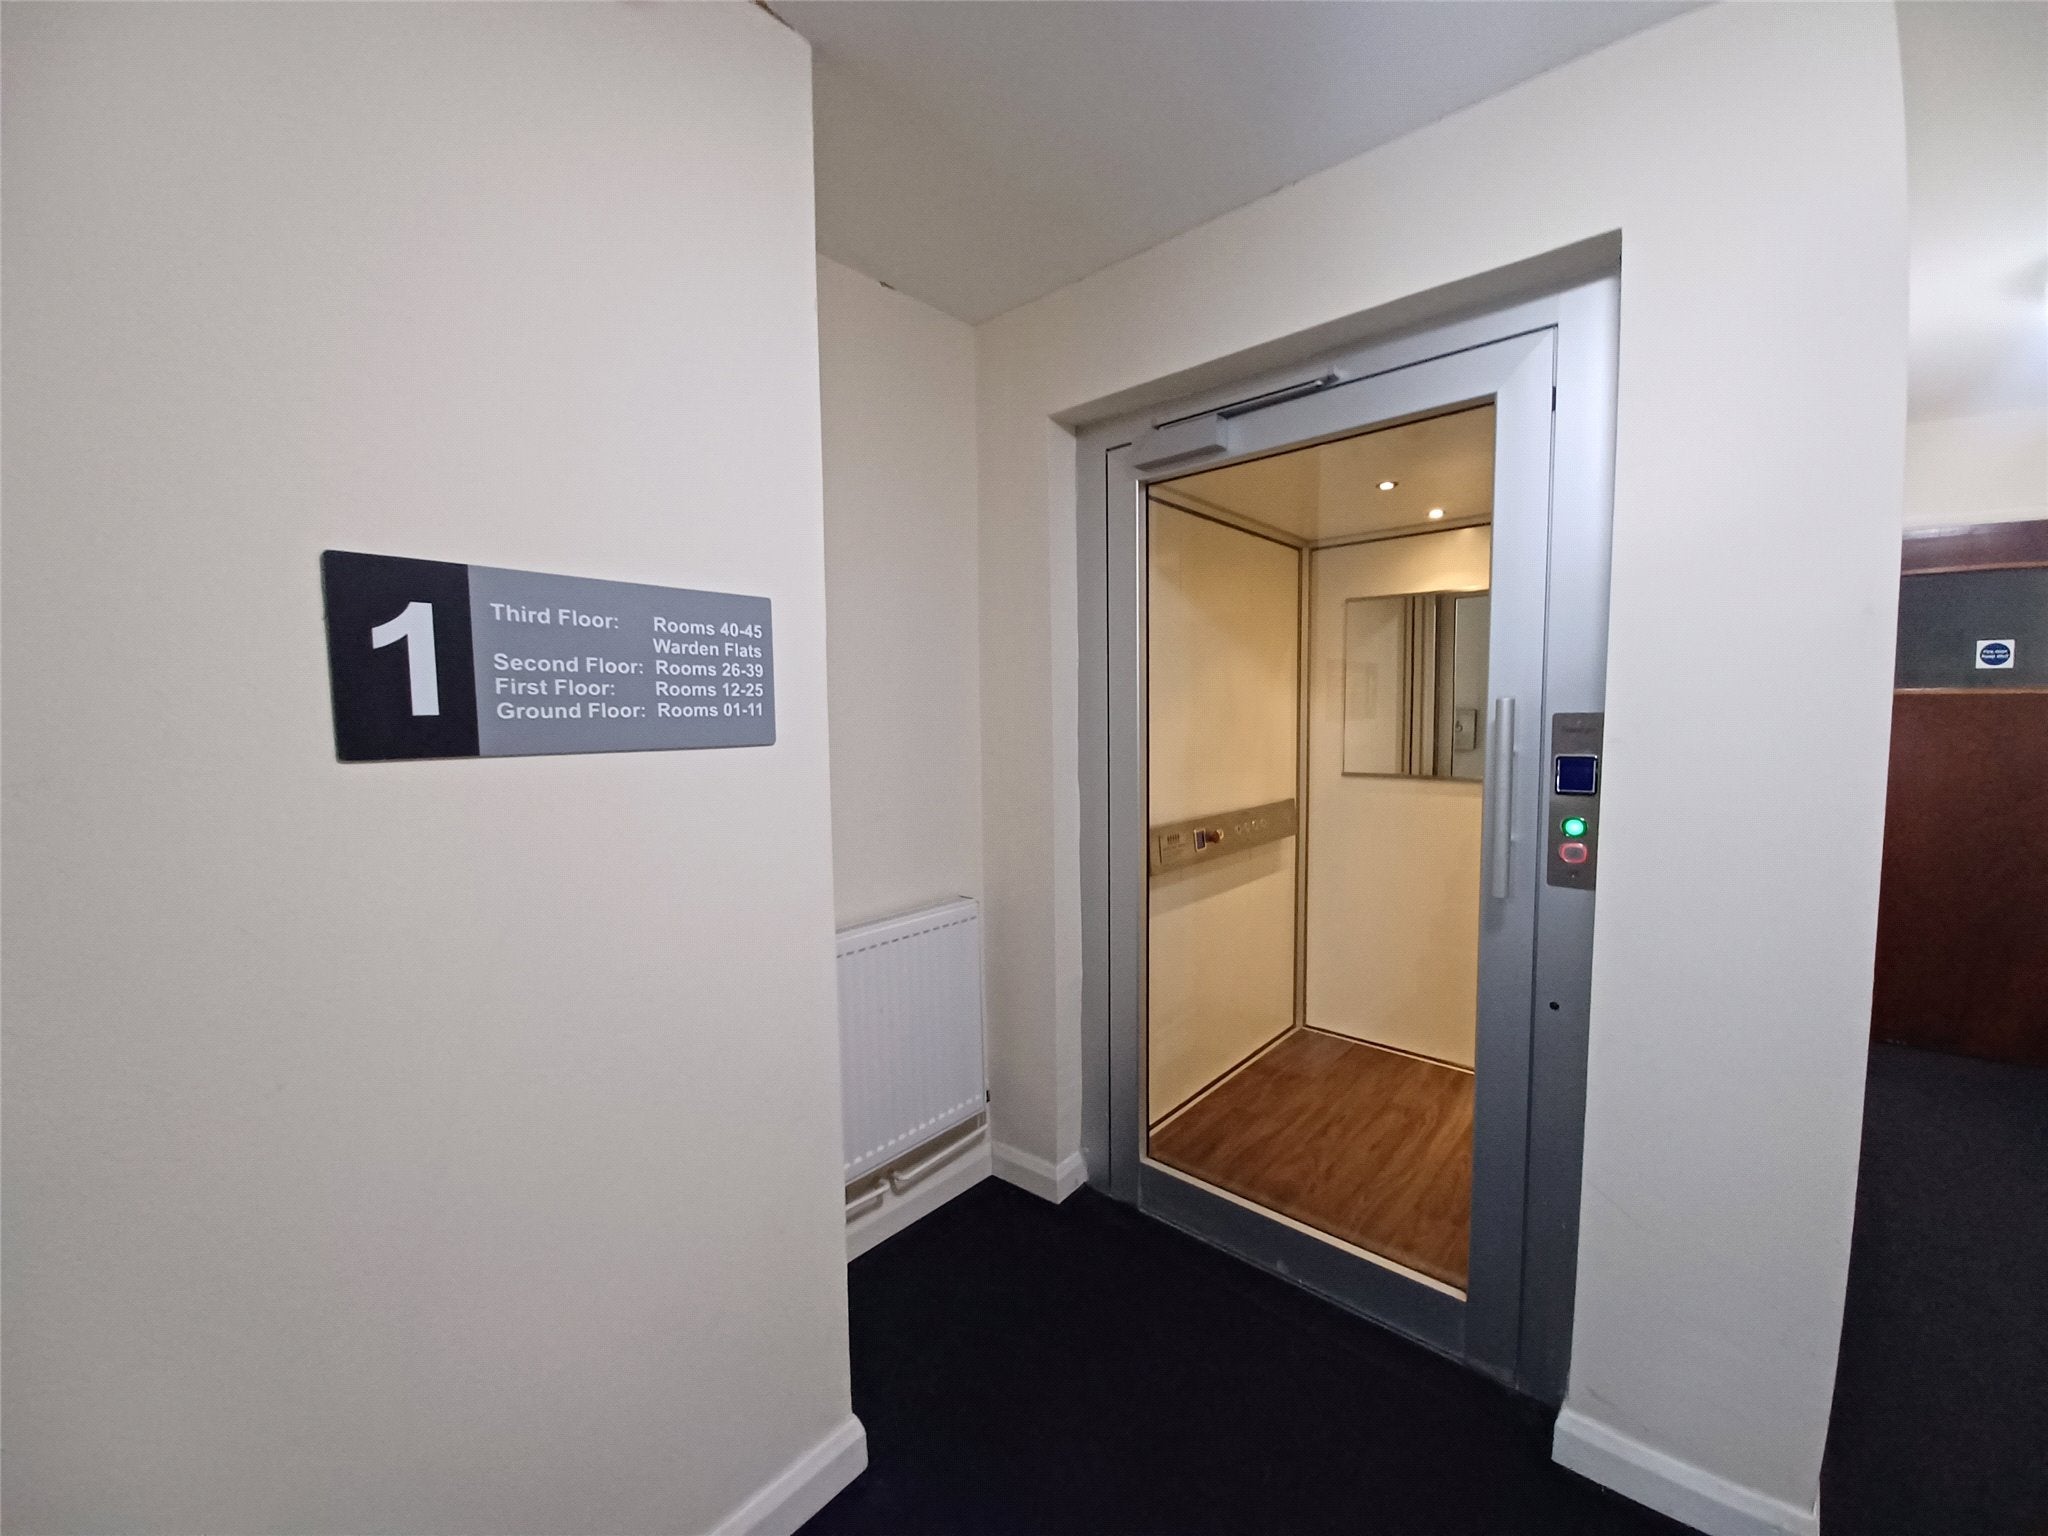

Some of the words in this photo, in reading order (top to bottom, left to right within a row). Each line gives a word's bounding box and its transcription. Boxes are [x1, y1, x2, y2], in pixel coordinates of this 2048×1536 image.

[489, 602, 551, 625] Third
[558, 608, 619, 630] Floor:
[653, 616, 716, 636] Rooms
[719, 621, 763, 639] 40-45
[371, 600, 441, 717] 1
[652, 637, 720, 657] Warden
[724, 642, 763, 659] Flats
[493, 652, 579, 673] Second
[585, 656, 644, 674] Floor:
[655, 659, 717, 677] Rooms
[721, 662, 764, 678] 26-39
[495, 677, 548, 696] First
[554, 678, 616, 696] Floor:
[655, 680, 717, 697] Rooms
[722, 682, 764, 697] 12-25
[496, 702, 582, 720] Ground
[588, 702, 646, 719] Floor:
[657, 702, 719, 718] Rooms
[723, 702, 763, 717] 01-11
